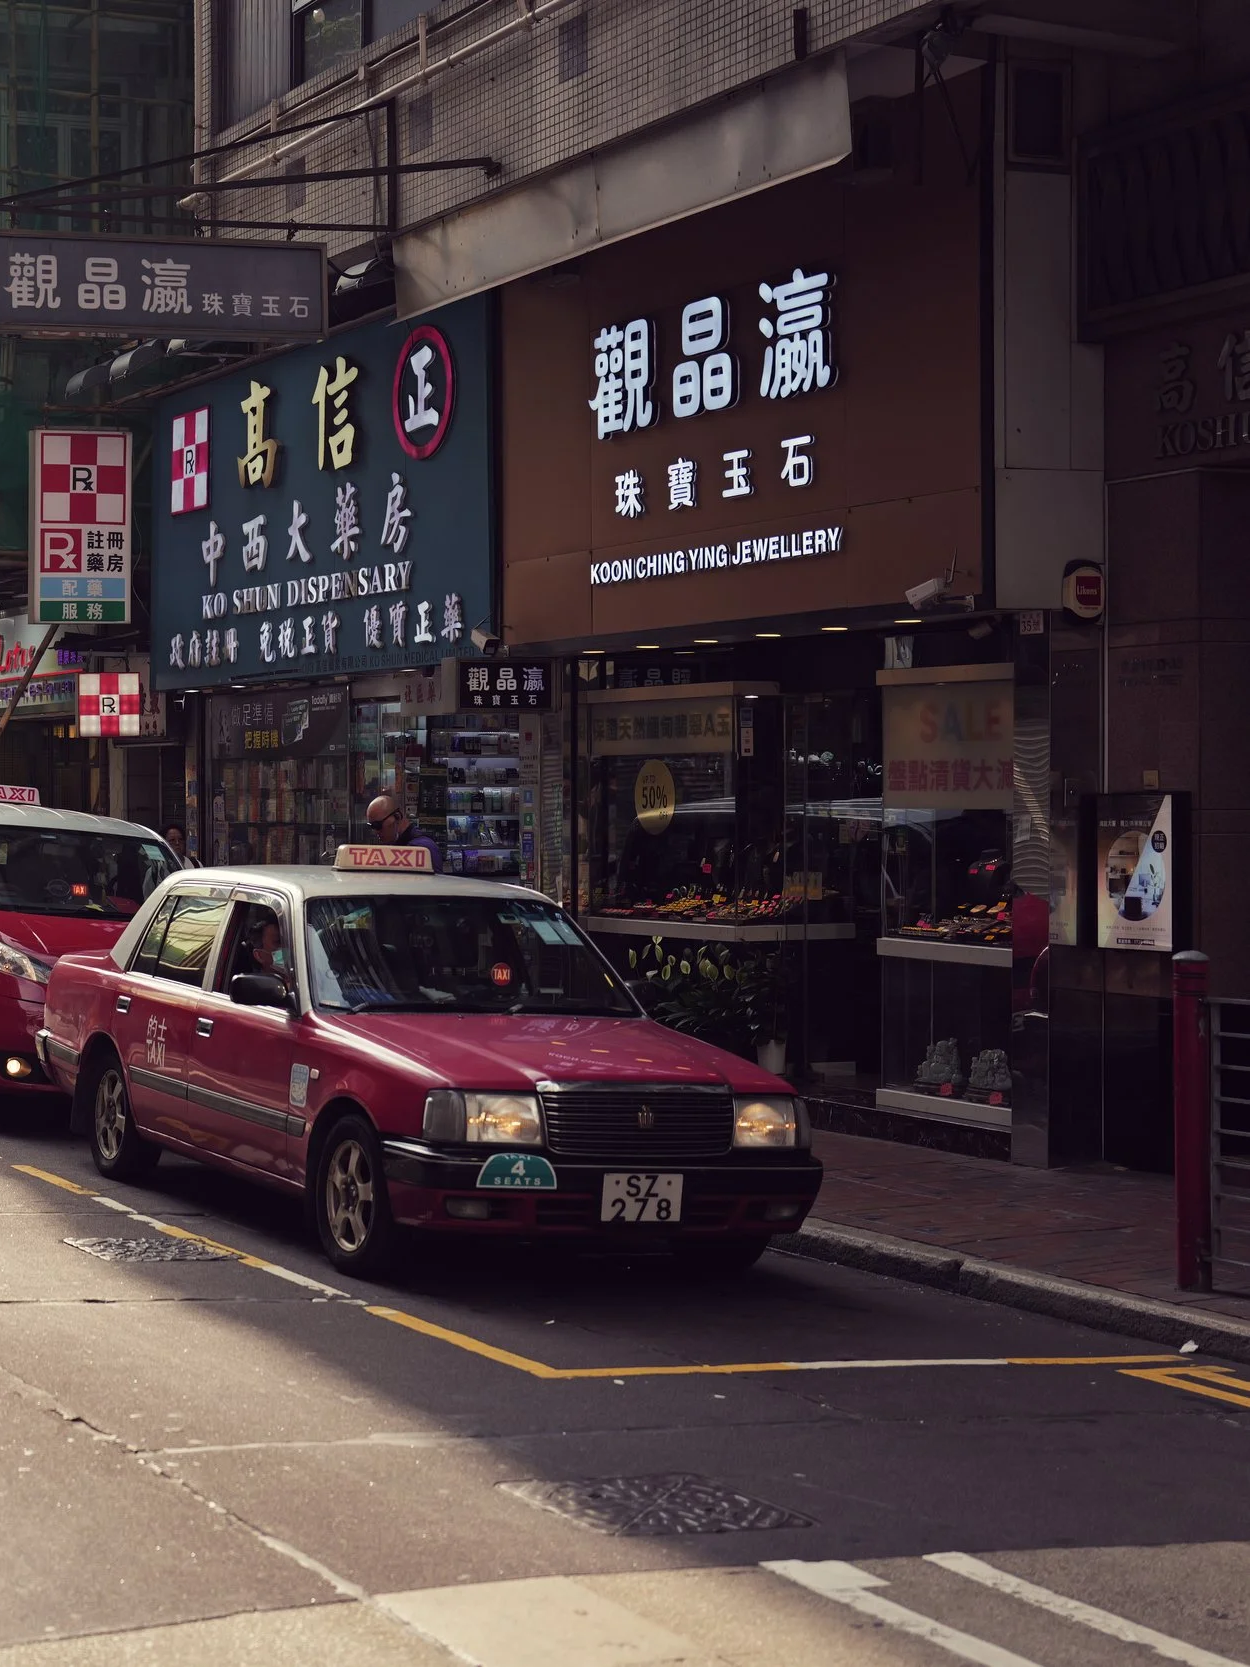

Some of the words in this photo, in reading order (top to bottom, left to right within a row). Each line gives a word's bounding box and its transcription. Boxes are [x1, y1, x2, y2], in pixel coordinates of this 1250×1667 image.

[4, 253, 192, 314] 觀晶瀛
[202, 292, 310, 318] 珠寶玉石
[588, 268, 834, 440] 觀晶瀛
[404, 345, 440, 433] 正
[615, 435, 813, 518] 珠寶玉石
[87, 531, 125, 550] 註冊
[201, 472, 413, 587] 中西大藥房
[86, 553, 124, 573] 藥房
[591, 560, 633, 585] KOON
[636, 551, 686, 579] CHING
[687, 544, 730, 571] YING
[731, 527, 841, 565] JEWELLERY
[61, 580, 103, 597] 配藥
[201, 592, 227, 619] KO
[233, 583, 282, 615] SHUN
[286, 560, 413, 608] DISPENSARY
[61, 603, 104, 620] 服務
[169, 627, 239, 669] 政府註冊
[363, 592, 463, 648] 優質正藥
[466, 666, 545, 692] 觀晶瀛
[473, 694, 537, 706] 珠寶玉石
[230, 702, 275, 728] 做足準備
[919, 700, 1003, 744] SALE
[243, 729, 279, 750] 把握時機
[642, 785, 668, 809] 50%
[349, 847, 425, 868] TAXI
[72, 884, 87, 896] TAXI
[492, 967, 511, 981] TAXI
[146, 1014, 168, 1042] 的士
[146, 1039, 166, 1068] TAXI
[511, 1160, 526, 1176] 4
[494, 1176, 541, 1186] SEATS
[625, 1174, 660, 1199] SZ
[610, 1198, 672, 1222] 278
